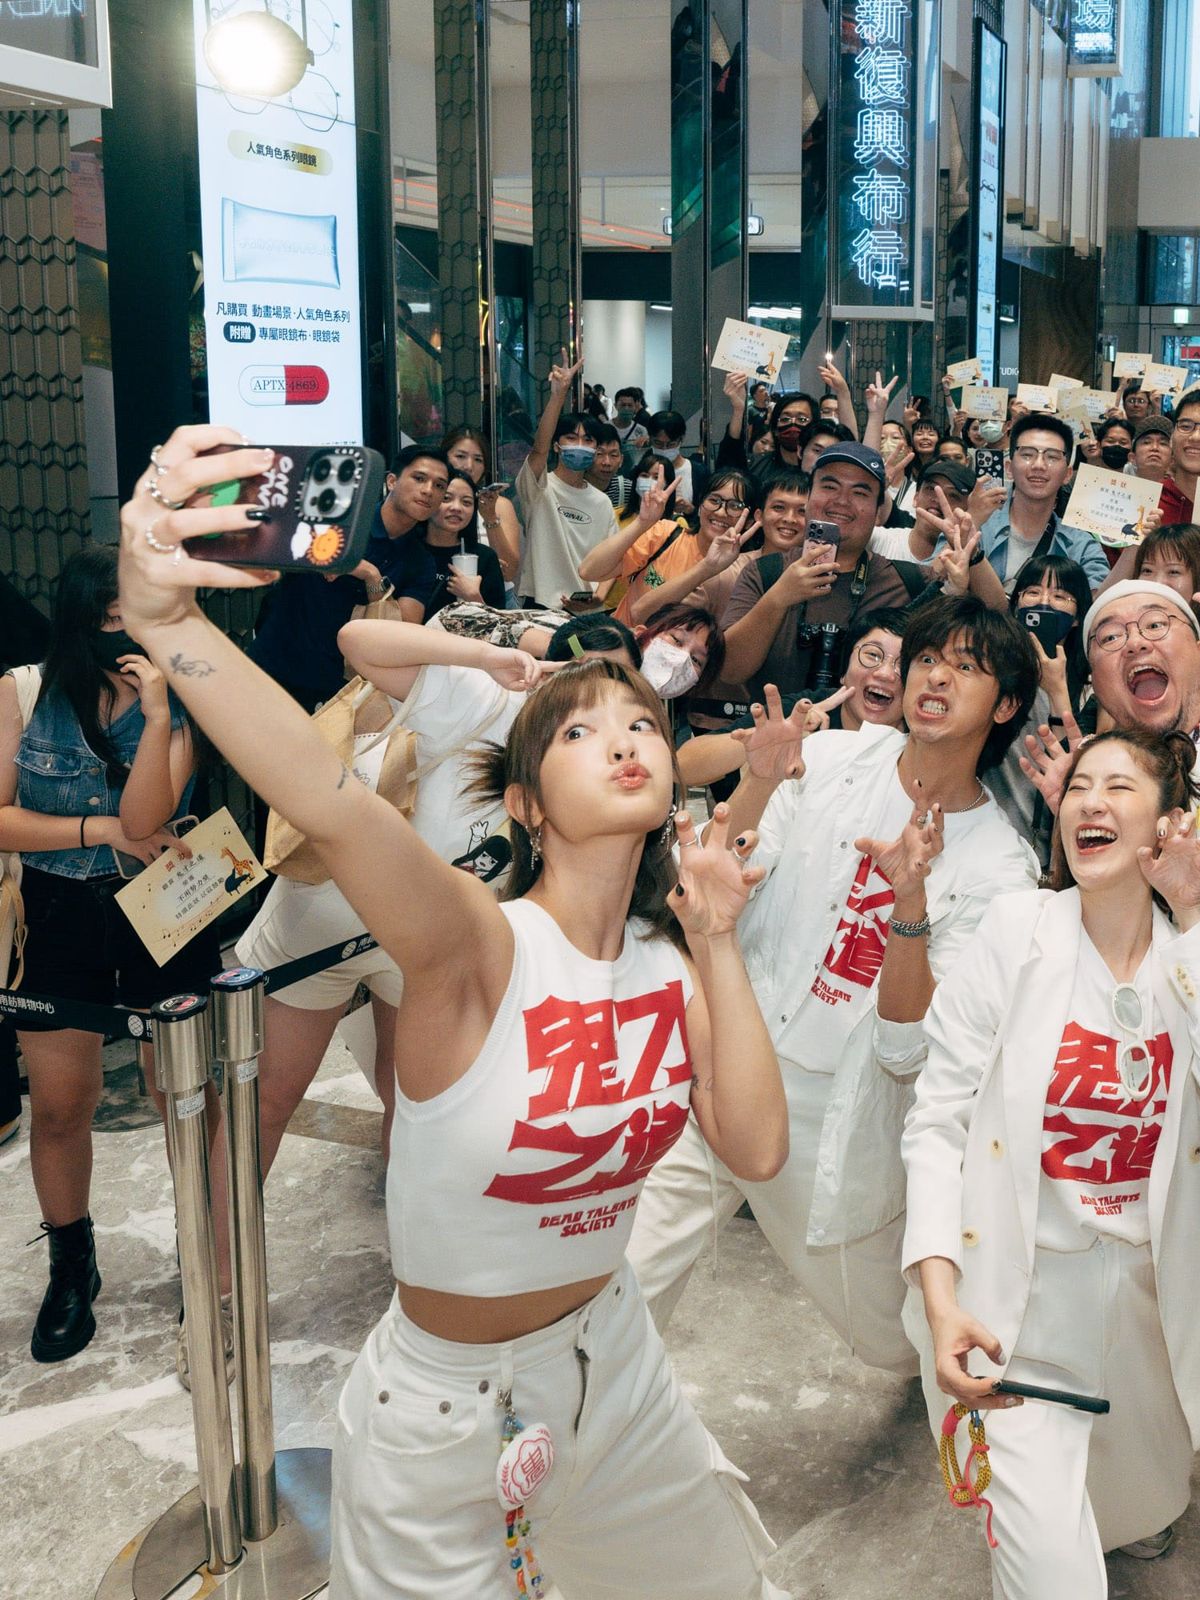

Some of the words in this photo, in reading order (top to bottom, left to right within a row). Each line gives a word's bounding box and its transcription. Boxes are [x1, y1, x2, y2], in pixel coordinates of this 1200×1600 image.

[247, 141, 318, 168] 人氣角色系列眼鏡
[852, 0, 910, 286] 新復興布行
[215, 301, 248, 318] 凡購買
[538, 1211, 583, 1230] DEAD
[586, 1195, 639, 1220] TALENTS
[559, 1214, 618, 1239] SOCIETY
